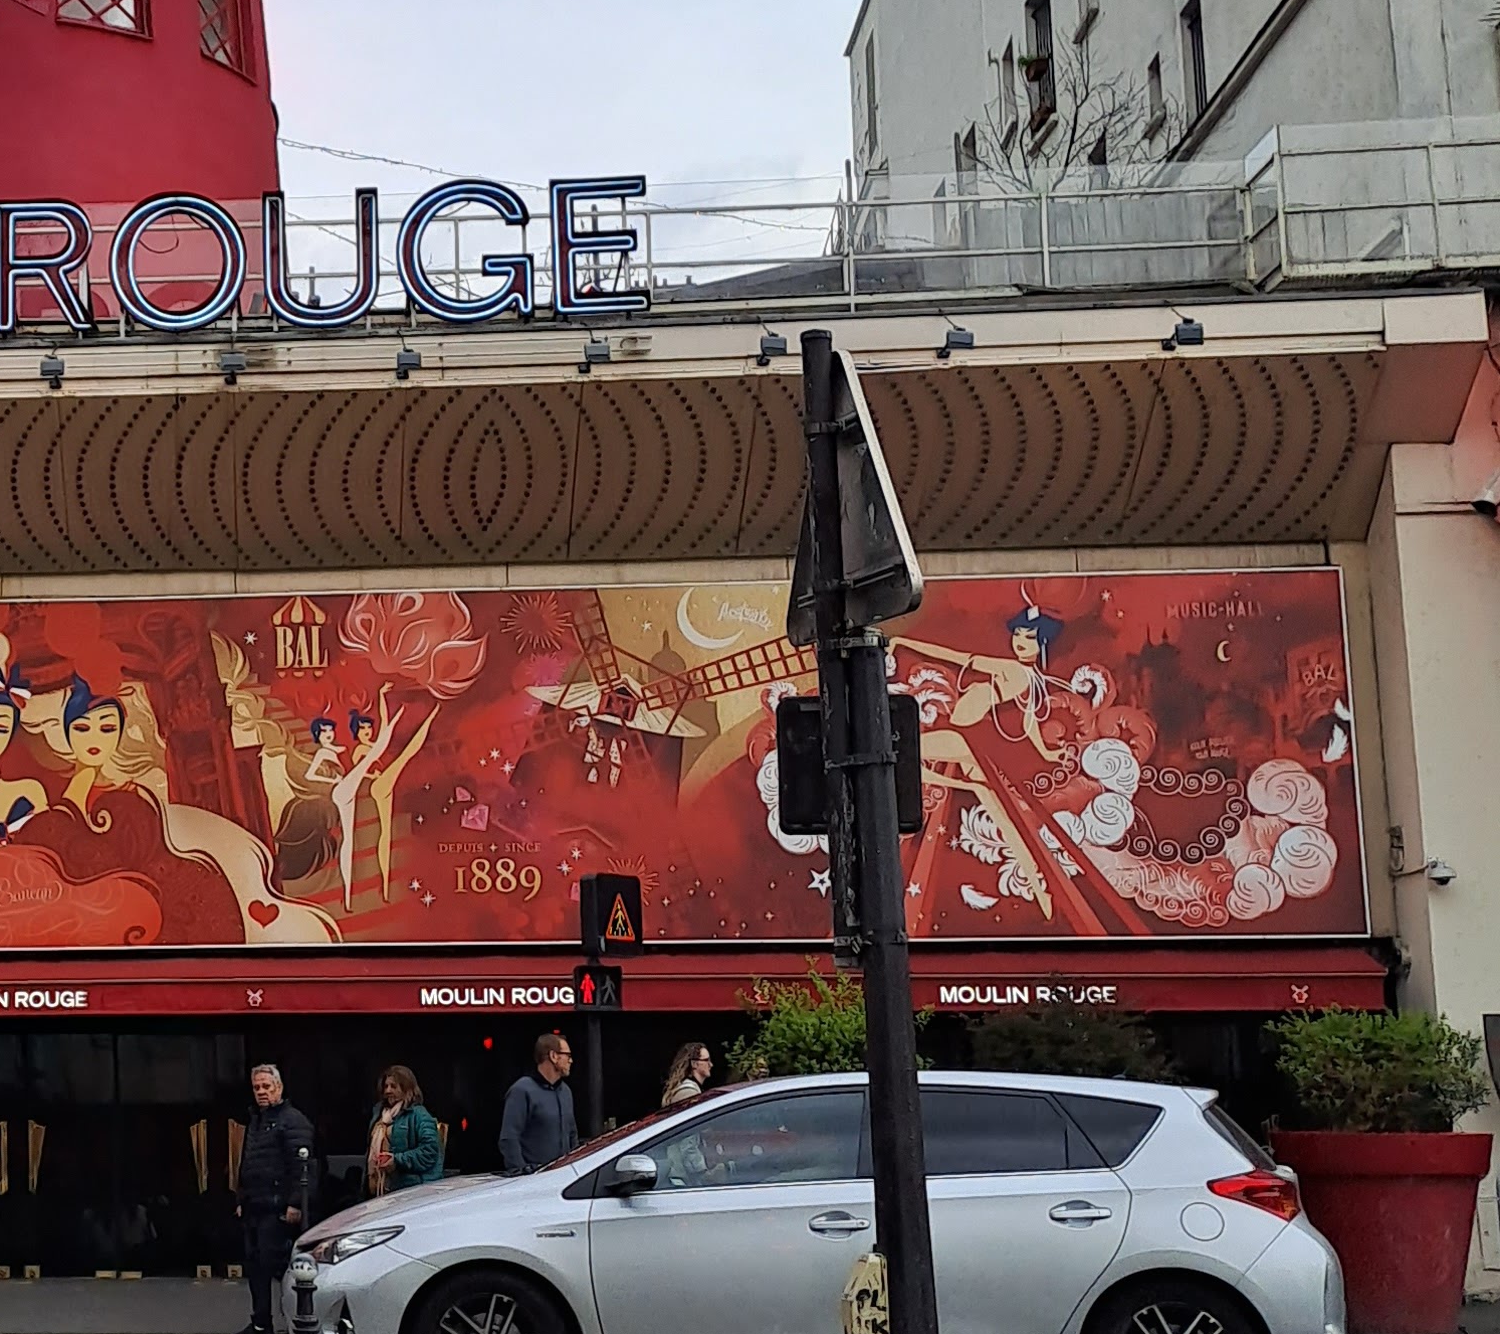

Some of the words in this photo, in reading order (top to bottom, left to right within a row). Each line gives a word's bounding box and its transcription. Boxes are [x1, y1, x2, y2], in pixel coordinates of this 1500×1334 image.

[275, 625, 329, 669] BAL
[1302, 663, 1336, 687] BAL
[438, 843, 484, 853] DEPUIS
[504, 842, 541, 853] SINCE
[453, 857, 542, 902] 1889
[14, 990, 88, 1008] ROUGE
[421, 988, 505, 1005] MOULIN
[512, 987, 575, 1004] ROUG
[939, 986, 1029, 1004] MOULIN
